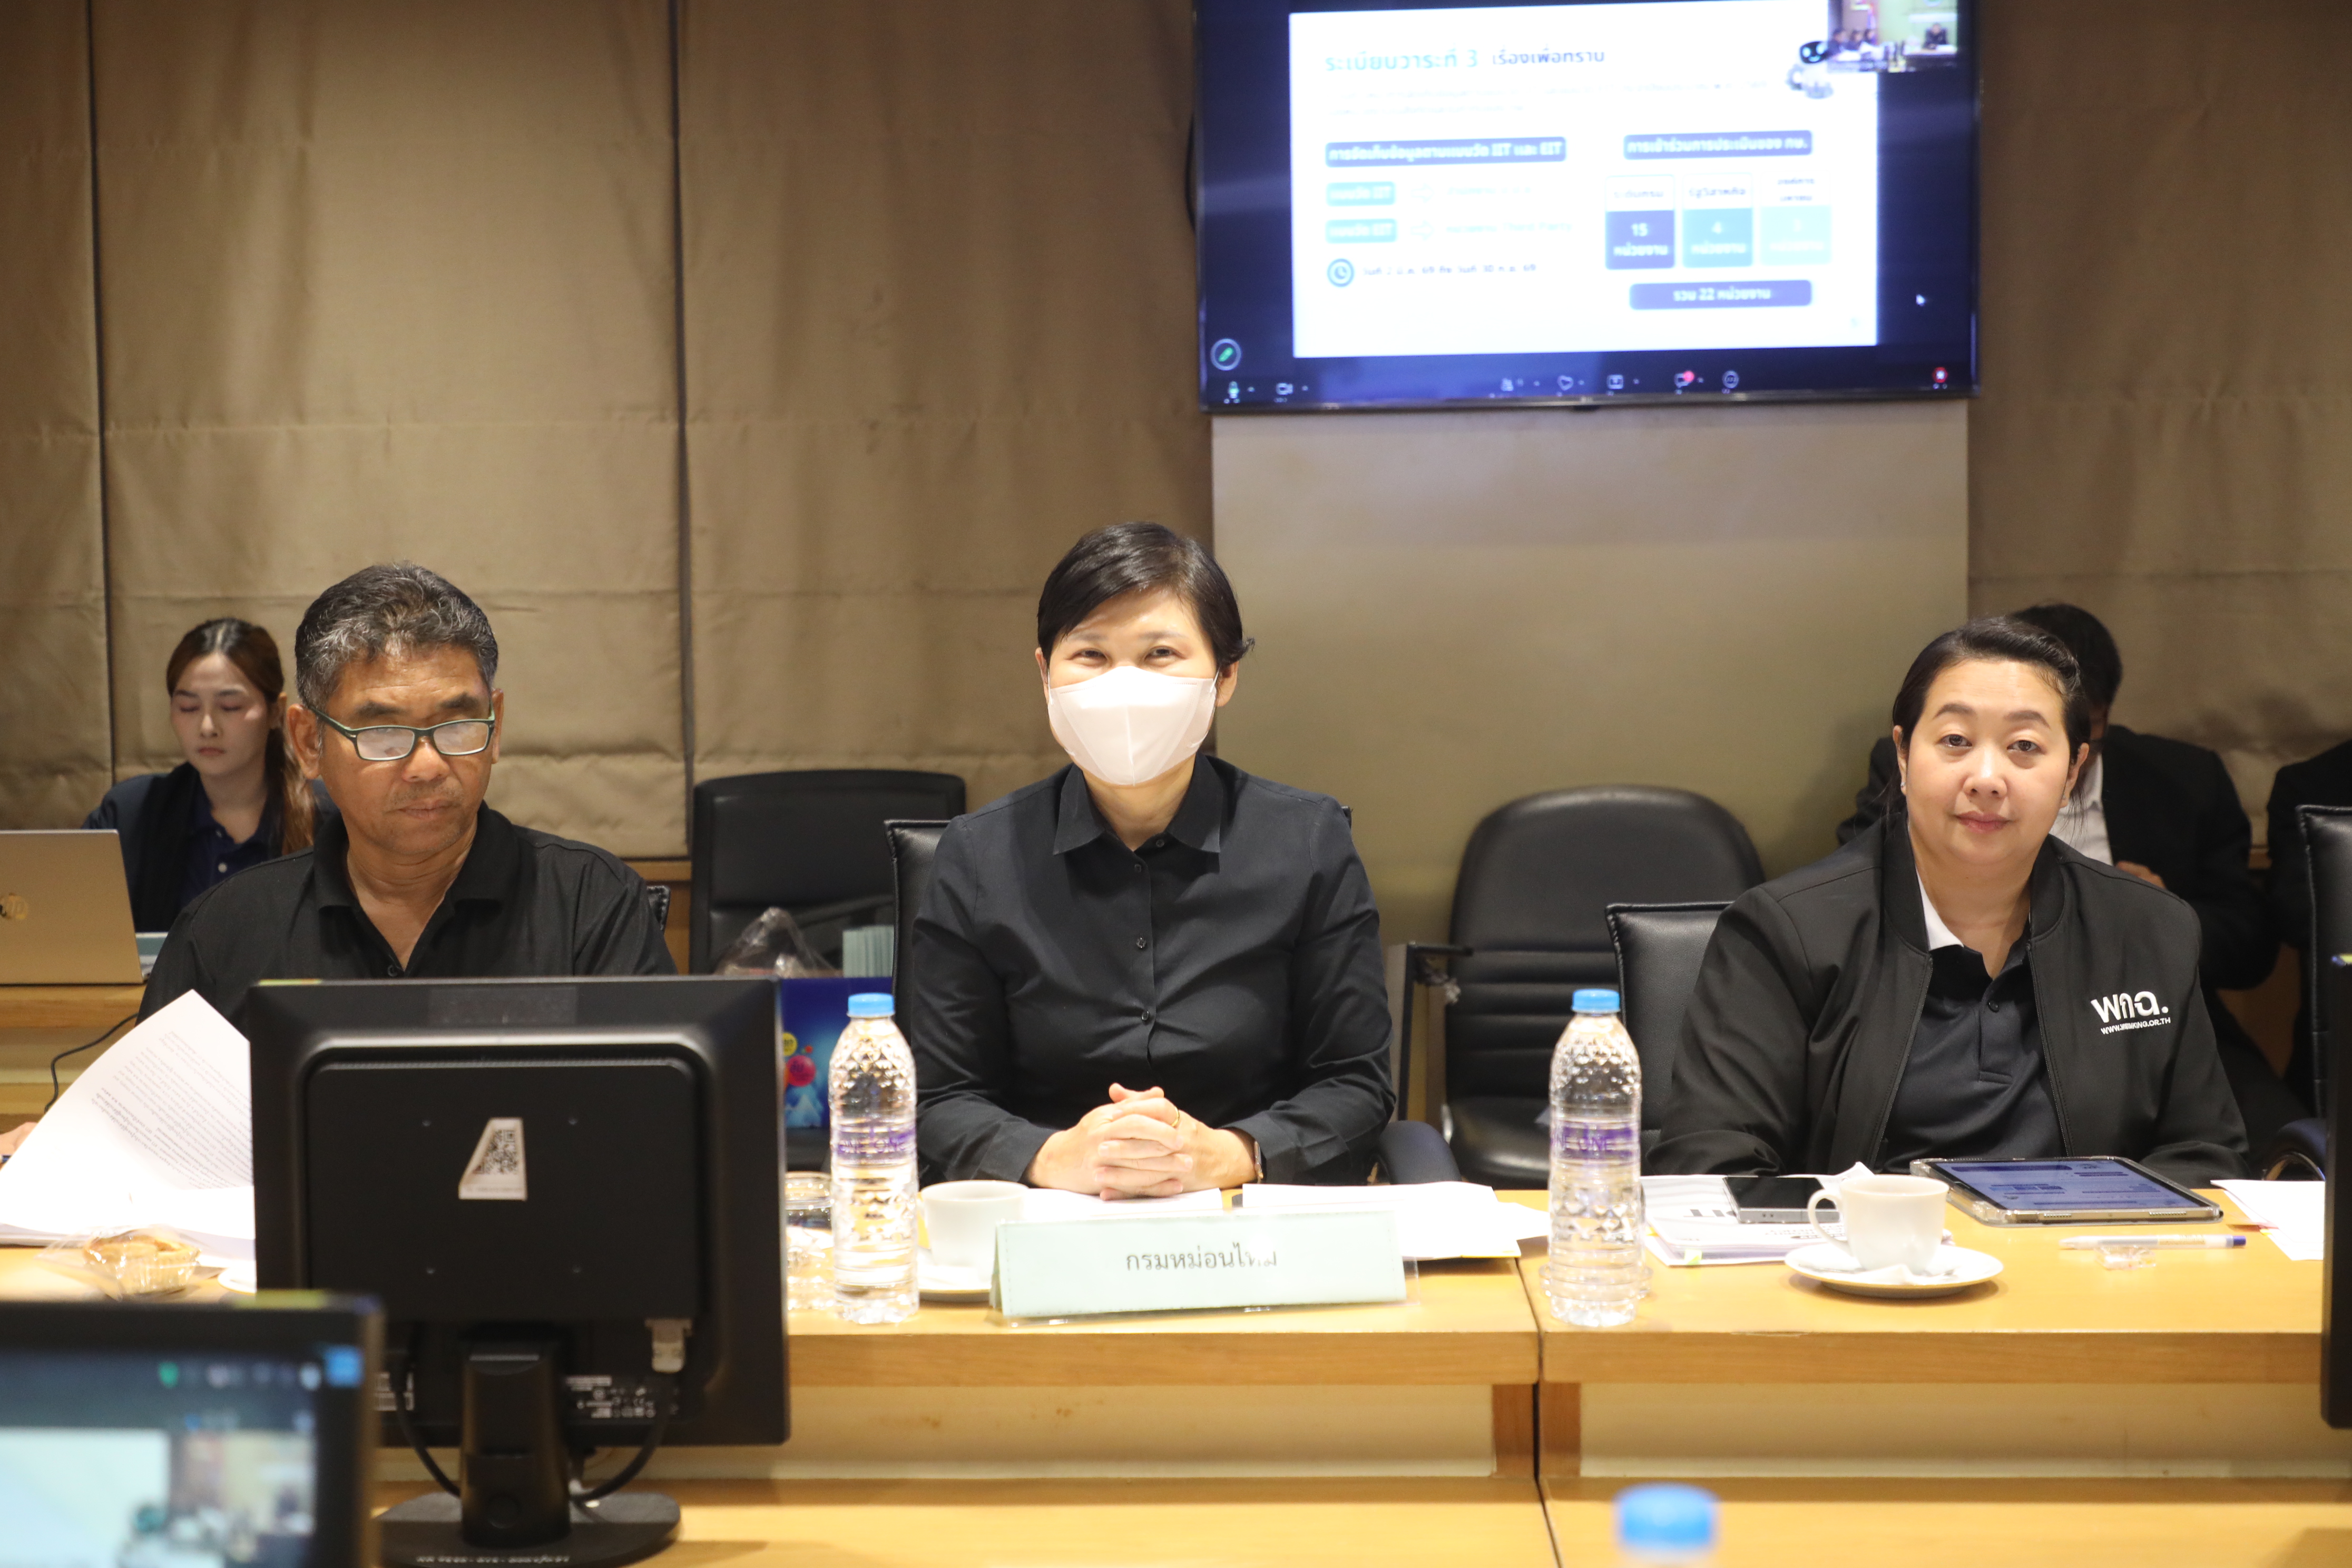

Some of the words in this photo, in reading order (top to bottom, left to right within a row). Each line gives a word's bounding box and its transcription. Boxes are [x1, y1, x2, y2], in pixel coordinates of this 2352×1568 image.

[1467, 49, 1478, 67] 3
[1492, 43, 1605, 65] เรื่องเพื่อทราบ
[1631, 223, 1648, 237] 15
[1711, 221, 1722, 234] 4
[1698, 288, 1716, 300] 22
